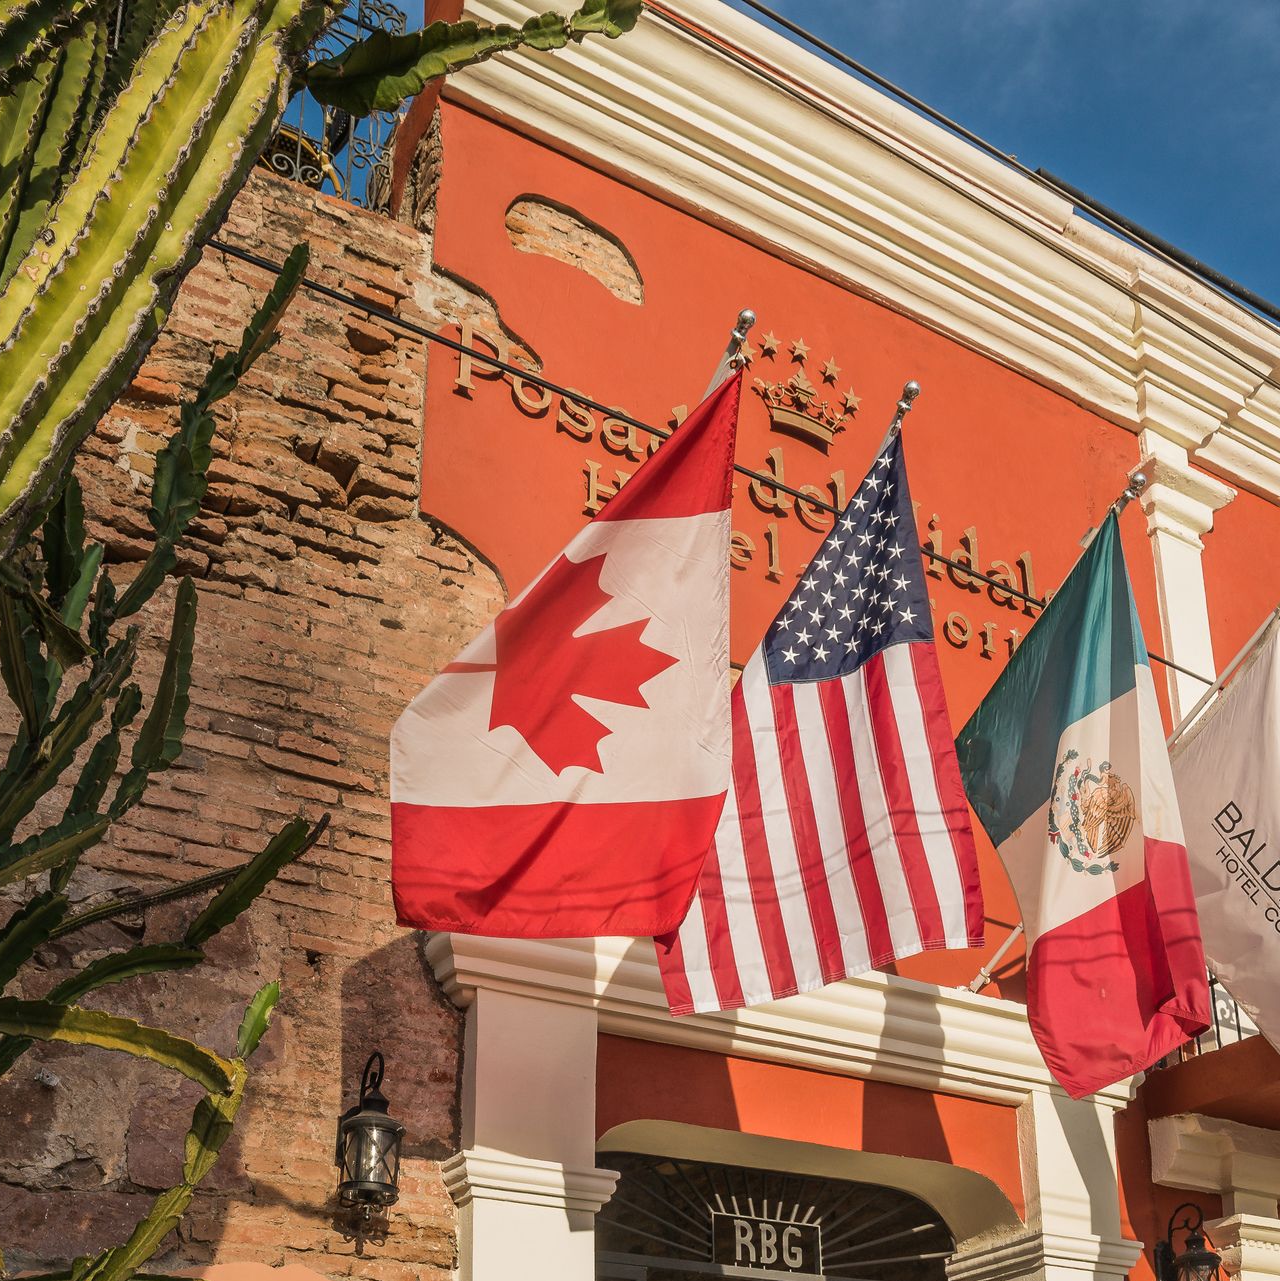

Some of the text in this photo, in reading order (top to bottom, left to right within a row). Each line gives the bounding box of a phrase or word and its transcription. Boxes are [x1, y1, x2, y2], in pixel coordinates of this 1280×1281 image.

[455, 318, 688, 454] Posa
[1216, 847, 1259, 905] HOTEL
[734, 1219, 803, 1268] RBG
